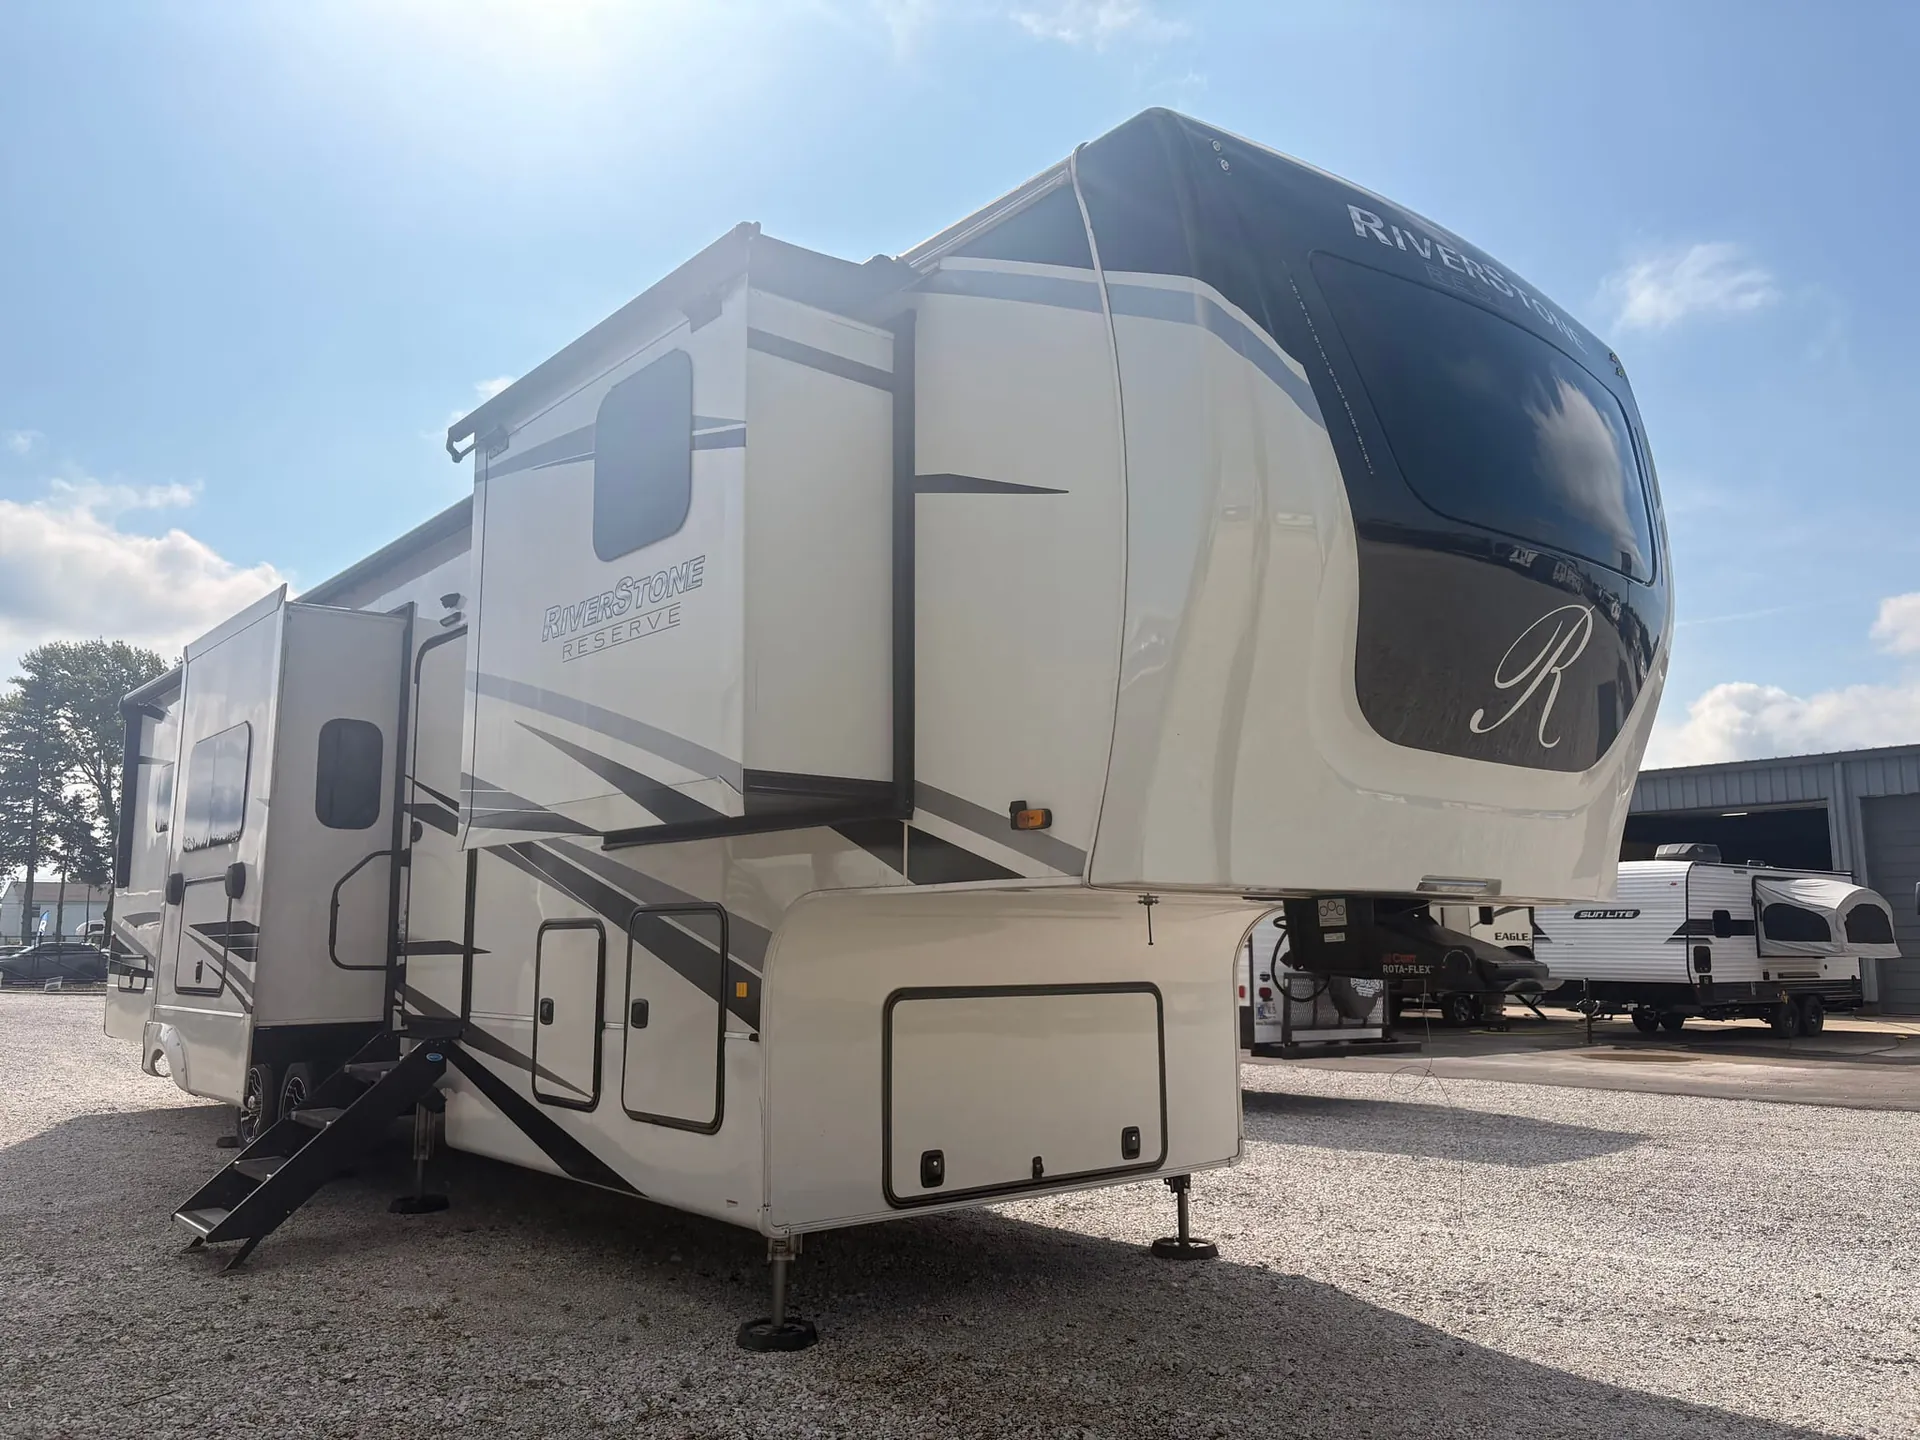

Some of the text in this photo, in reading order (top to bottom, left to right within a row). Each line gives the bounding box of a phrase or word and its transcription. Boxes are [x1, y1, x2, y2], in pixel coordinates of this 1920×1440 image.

[541, 554, 706, 642] RIVERSTONE
[562, 604, 681, 660] RESERVE
[1469, 604, 1596, 749] R
[1494, 932, 1529, 941] EAGLE
